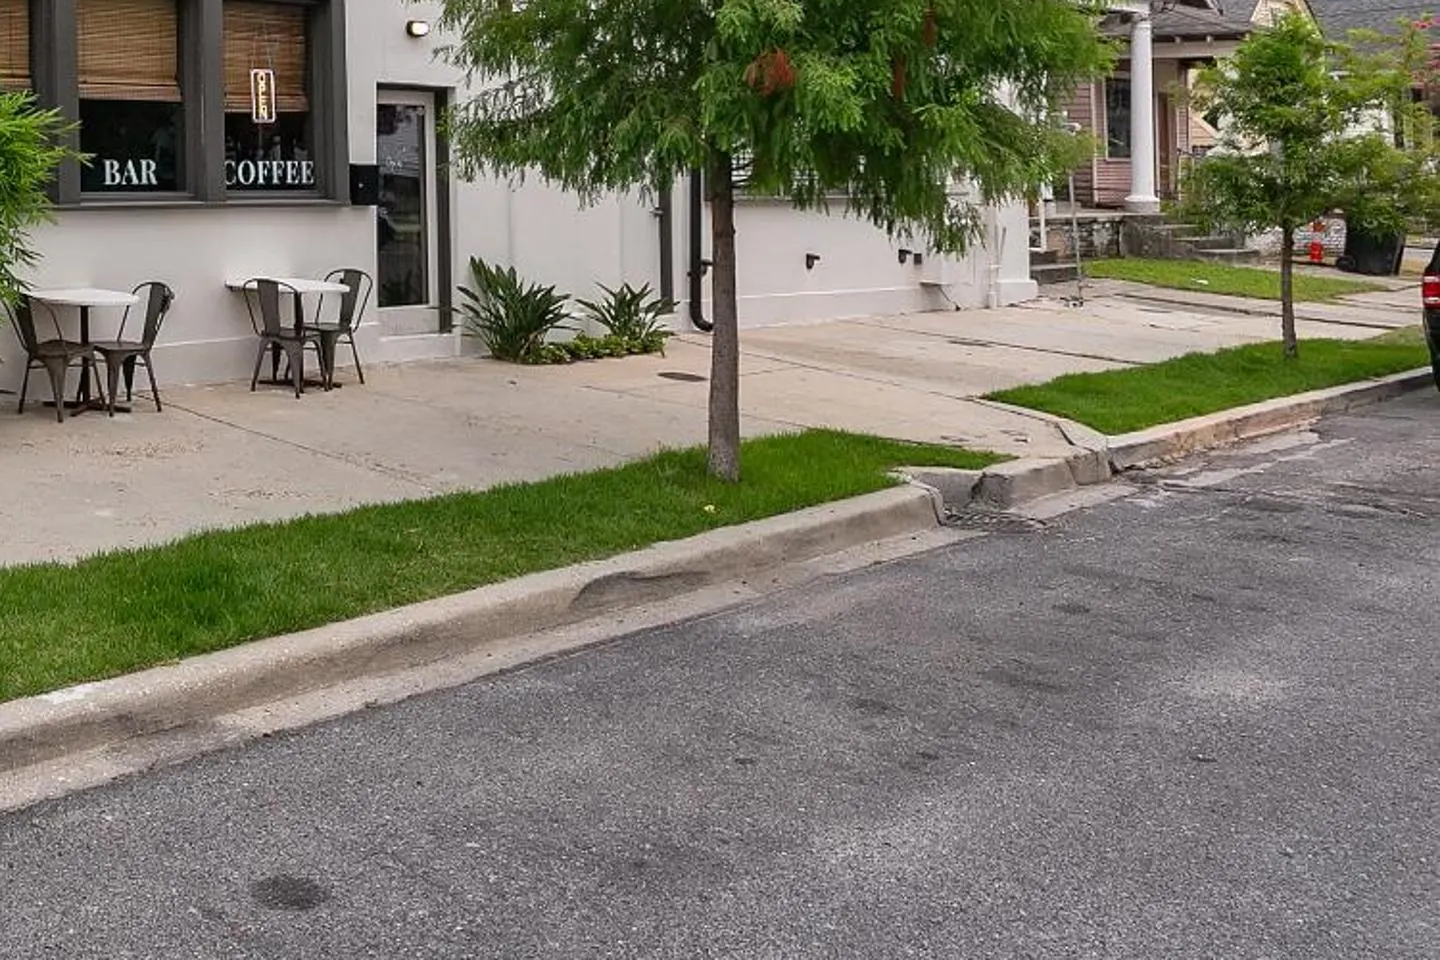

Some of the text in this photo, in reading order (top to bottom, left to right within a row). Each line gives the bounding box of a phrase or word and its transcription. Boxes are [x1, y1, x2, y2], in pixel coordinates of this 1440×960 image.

[257, 71, 268, 120] OPEN
[104, 159, 158, 186] BAR
[224, 160, 314, 185] COFFEE
